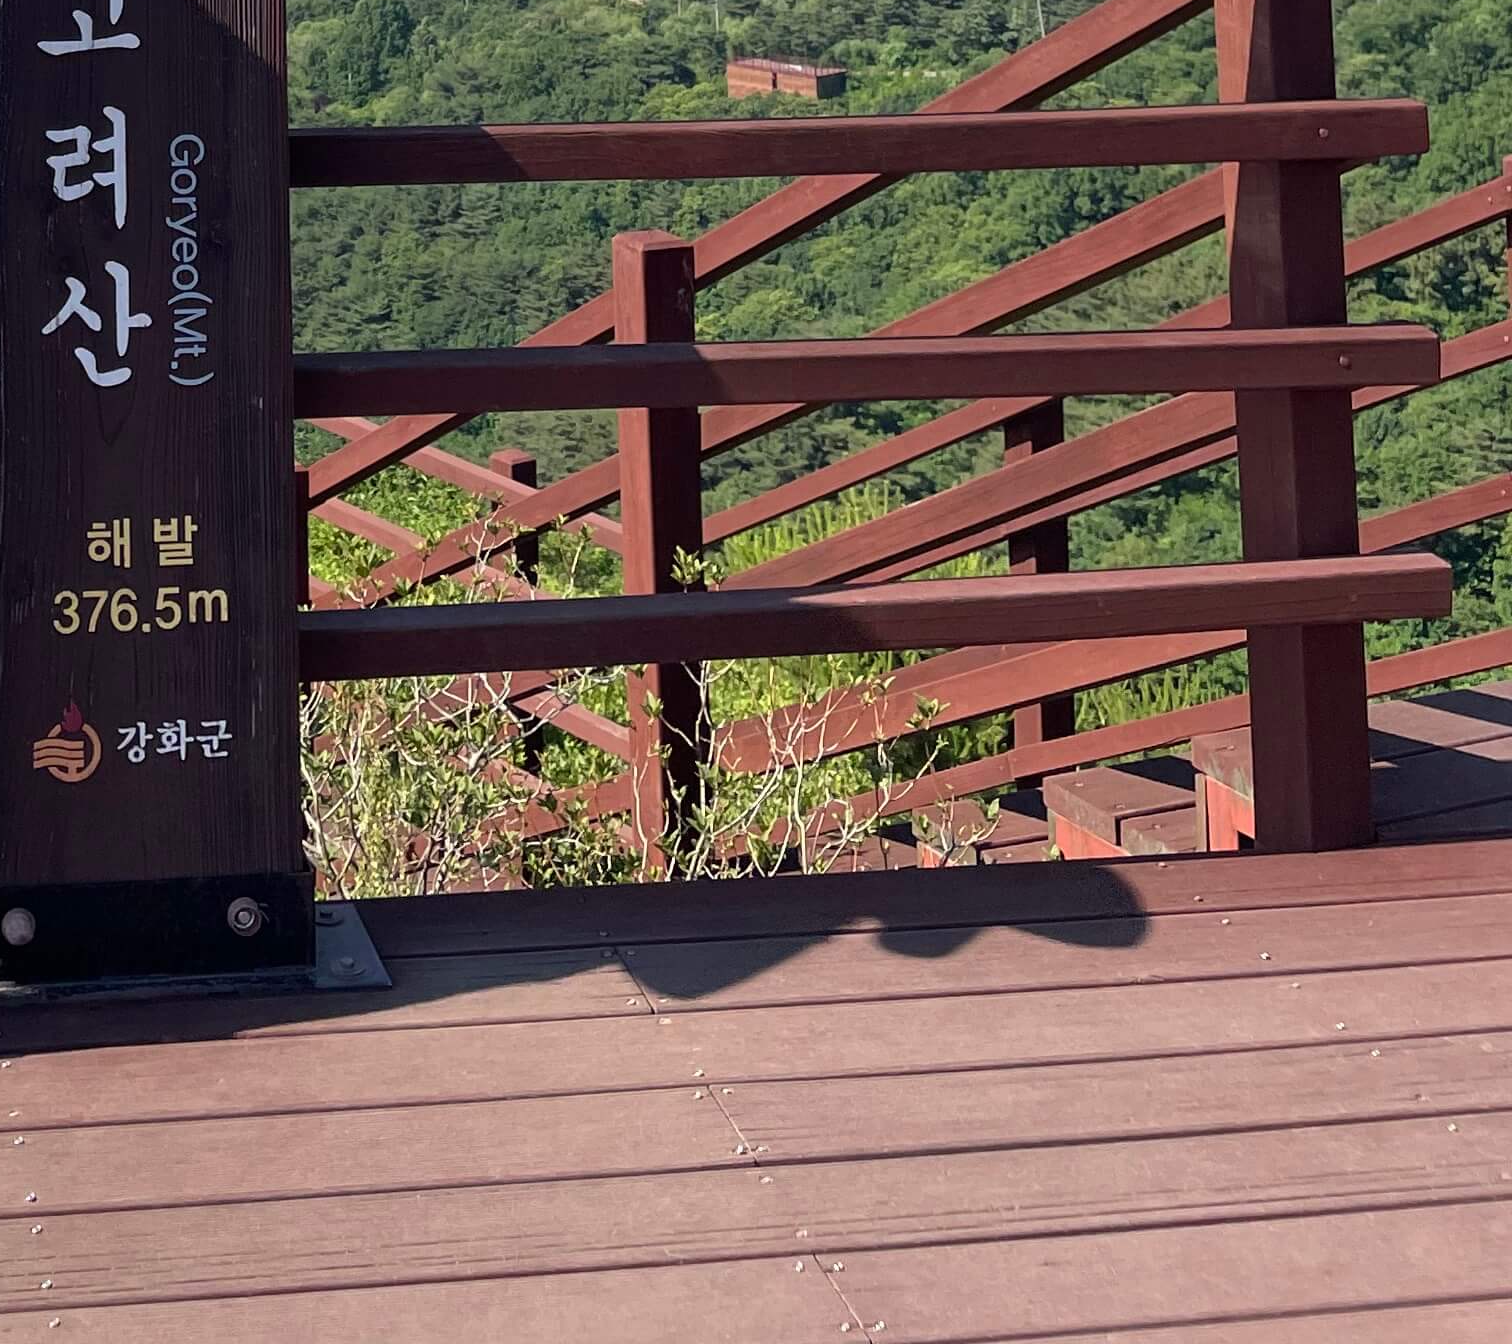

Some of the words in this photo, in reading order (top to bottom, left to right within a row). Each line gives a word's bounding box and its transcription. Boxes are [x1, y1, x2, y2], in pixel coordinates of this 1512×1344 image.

[167, 134, 214, 387] Goryeo(Mt.)
[53, 586, 229, 635] 376.5m
[117, 719, 233, 763] 강화군
